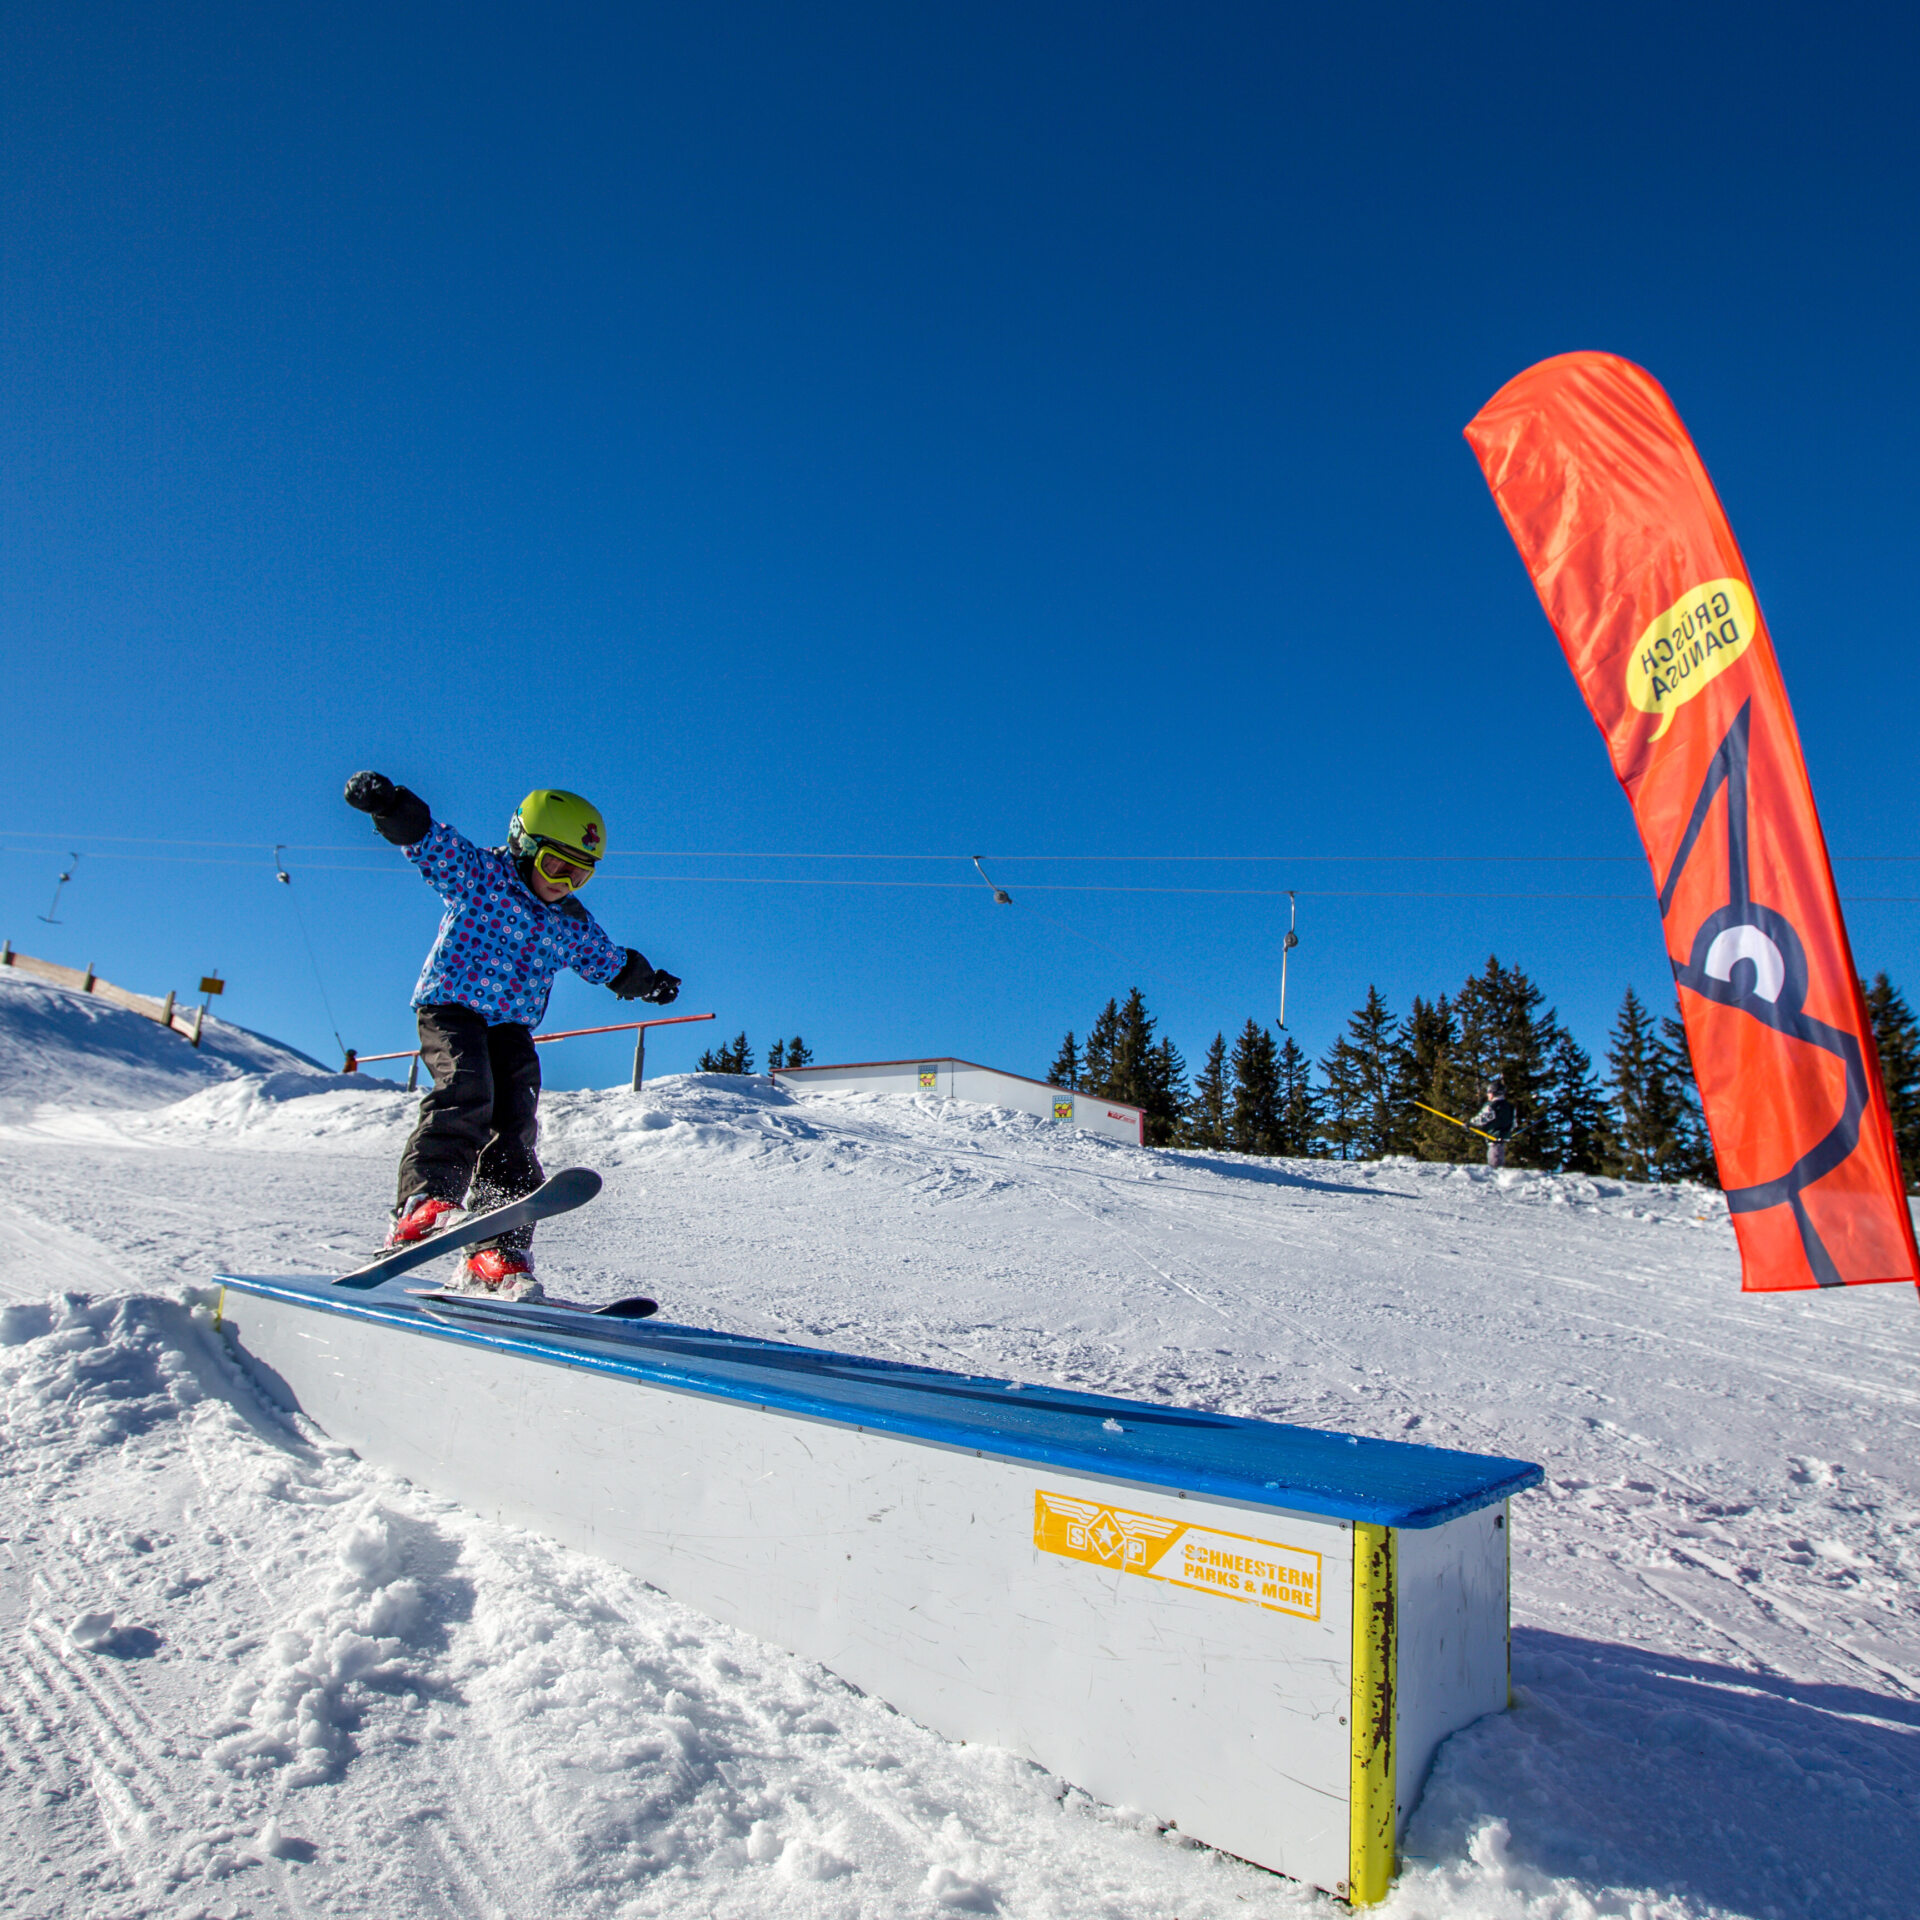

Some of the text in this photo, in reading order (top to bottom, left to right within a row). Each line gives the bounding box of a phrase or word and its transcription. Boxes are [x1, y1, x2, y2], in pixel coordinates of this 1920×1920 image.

[1184, 1544, 1314, 1589] SCHNEESTERN
[1184, 1563, 1313, 1608] PARKS & MORE
